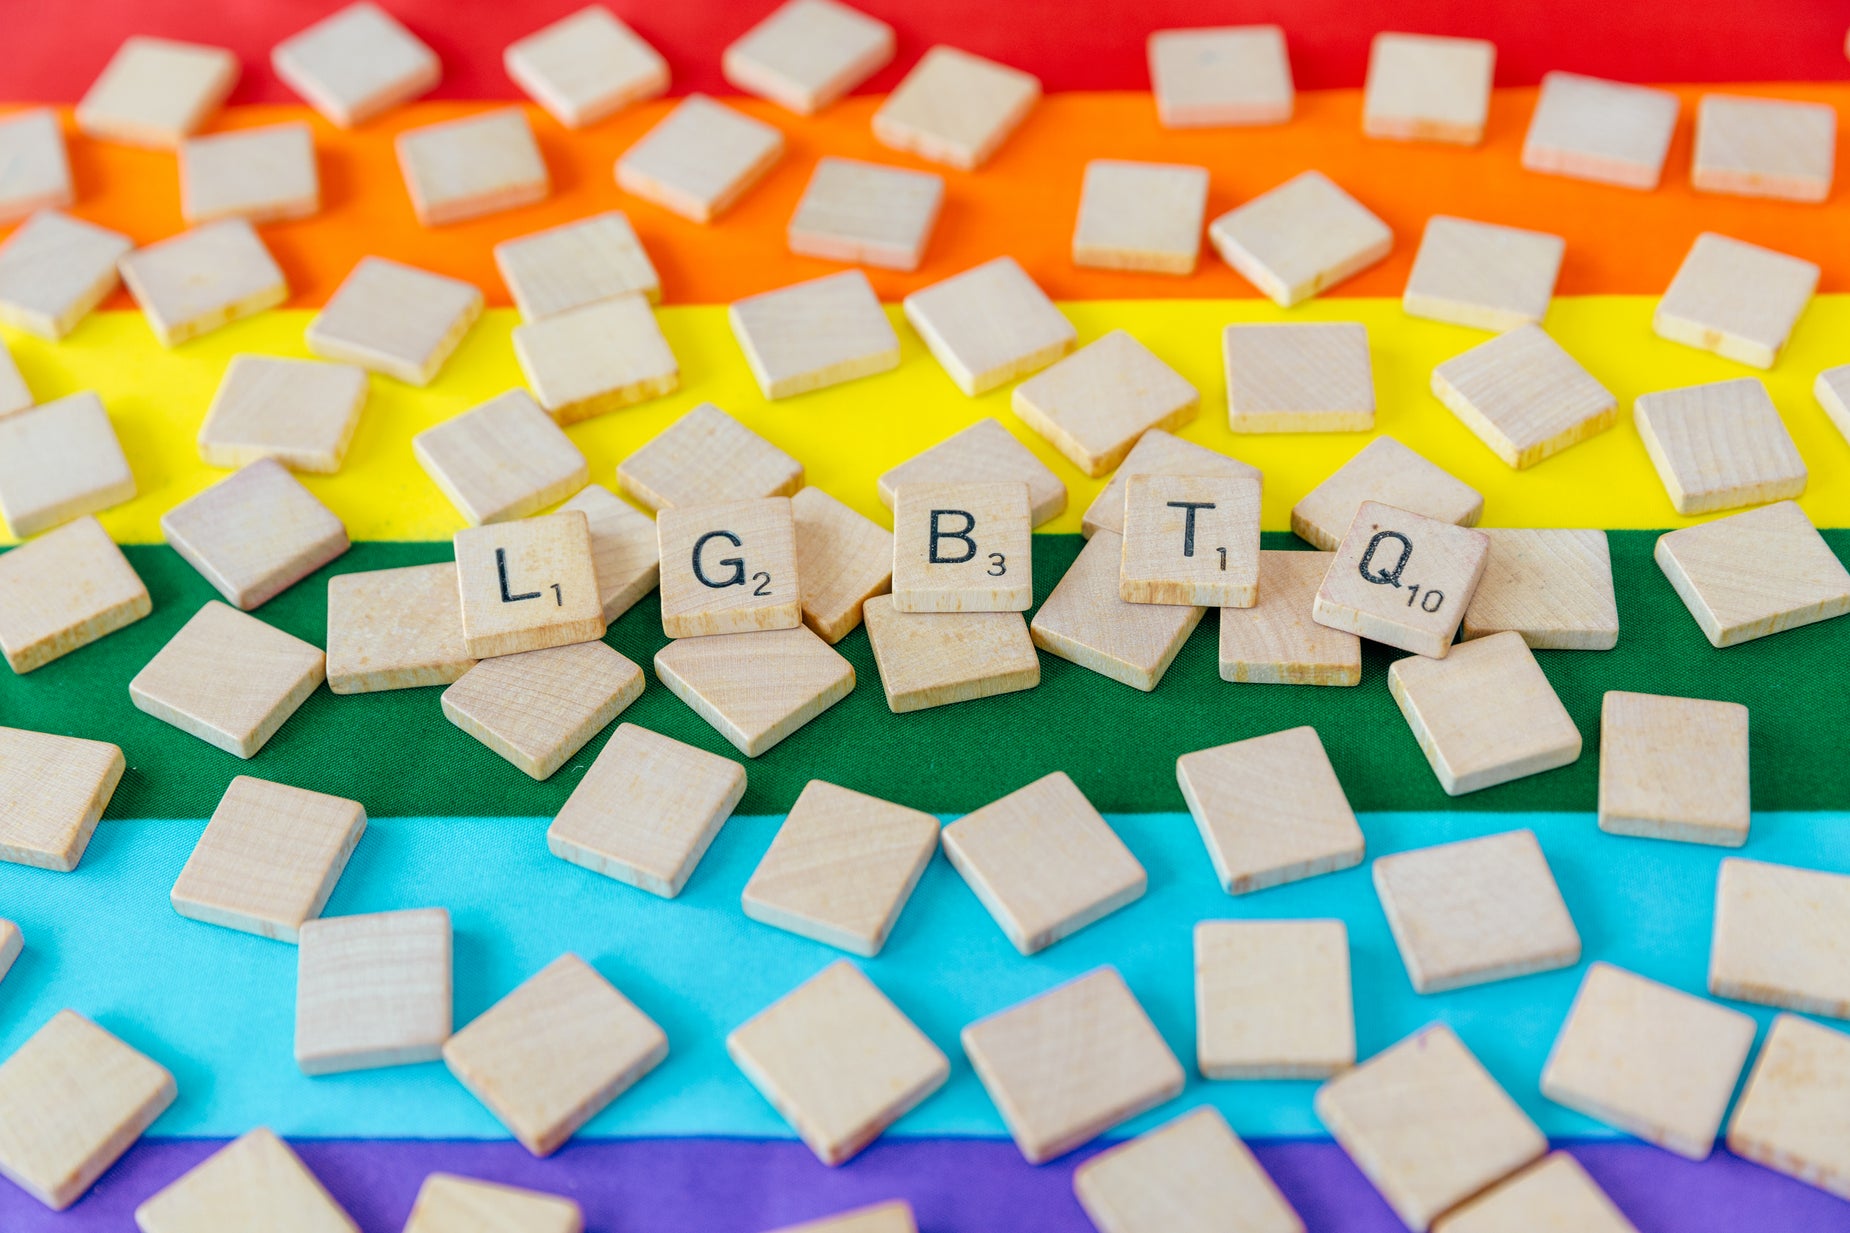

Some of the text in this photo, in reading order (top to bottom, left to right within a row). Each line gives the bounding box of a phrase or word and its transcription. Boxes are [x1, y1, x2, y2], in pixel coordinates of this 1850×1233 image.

[691, 530, 773, 597] G 2
[928, 509, 1008, 577] B 3
[1166, 501, 1227, 571] T 1
[495, 547, 563, 607] L 1
[1358, 530, 1445, 613] Q 10
